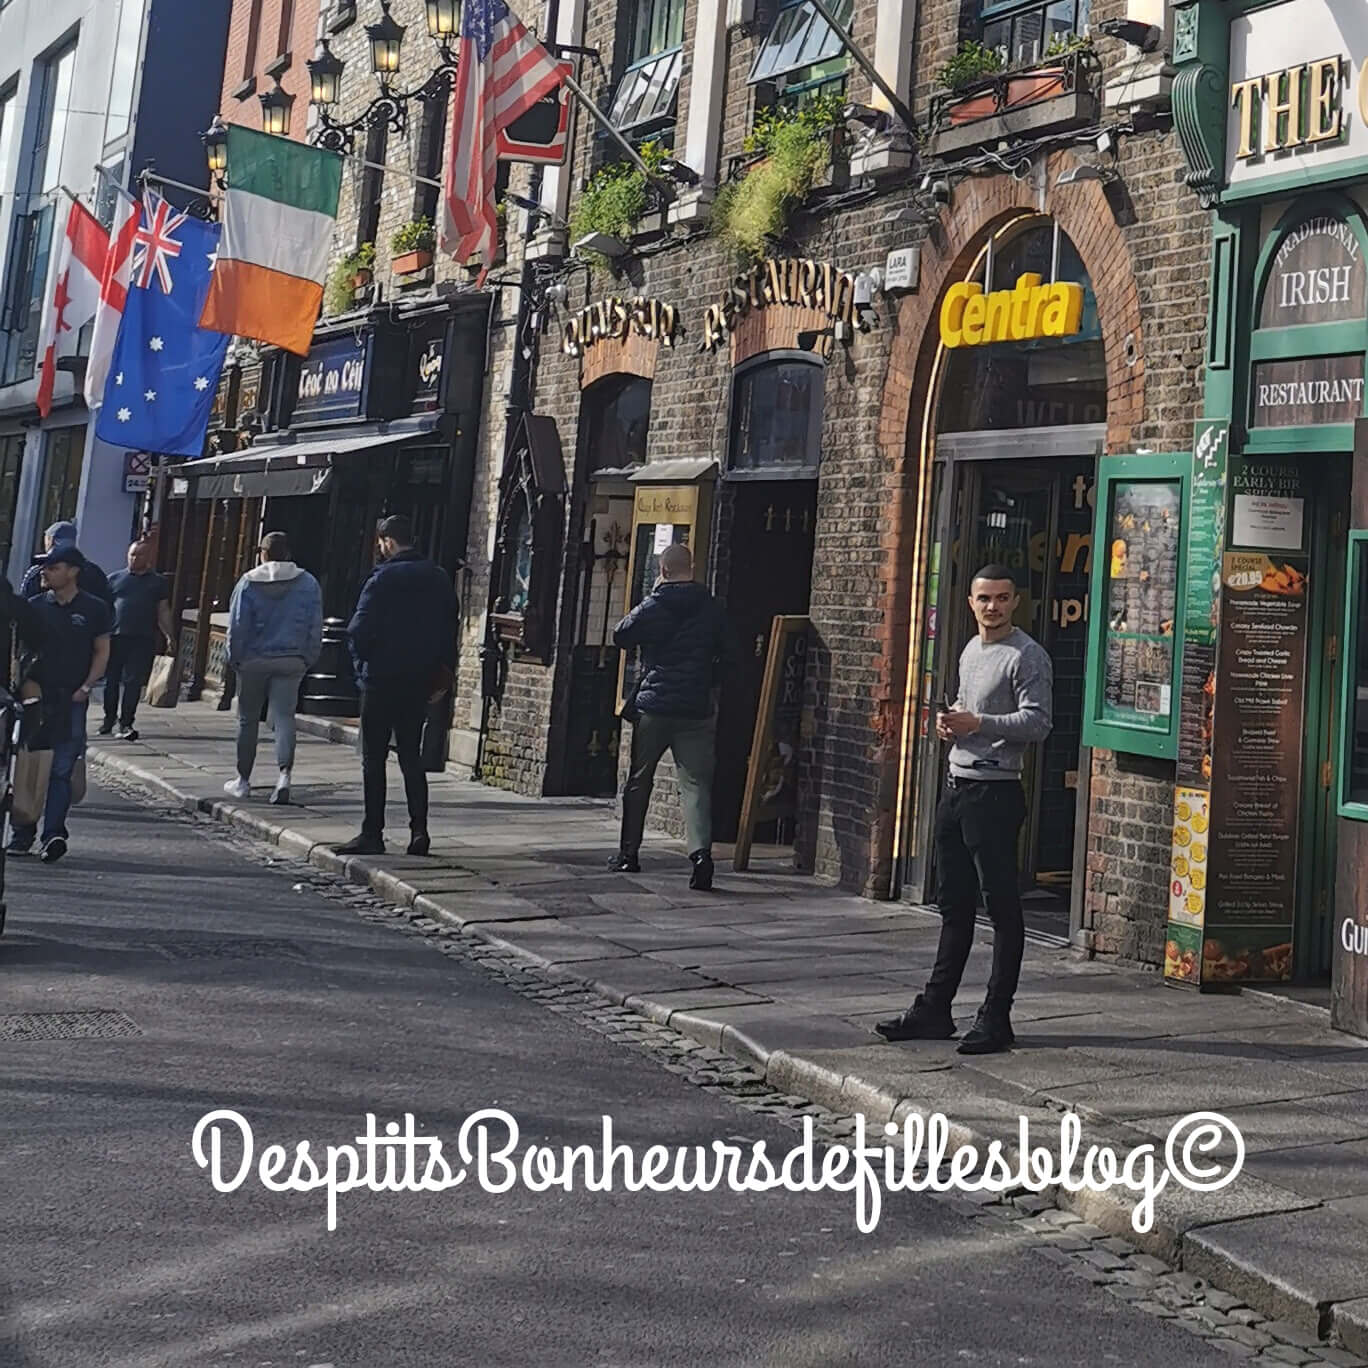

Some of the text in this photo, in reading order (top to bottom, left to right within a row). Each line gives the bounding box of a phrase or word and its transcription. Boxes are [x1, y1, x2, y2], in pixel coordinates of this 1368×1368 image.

[1231, 54, 1344, 160] THE
[1274, 216, 1360, 267] TRADITIONAL
[940, 272, 1083, 348] Centra
[1279, 265, 1352, 308] IRISH
[1258, 378, 1364, 407] RESTAURANT
